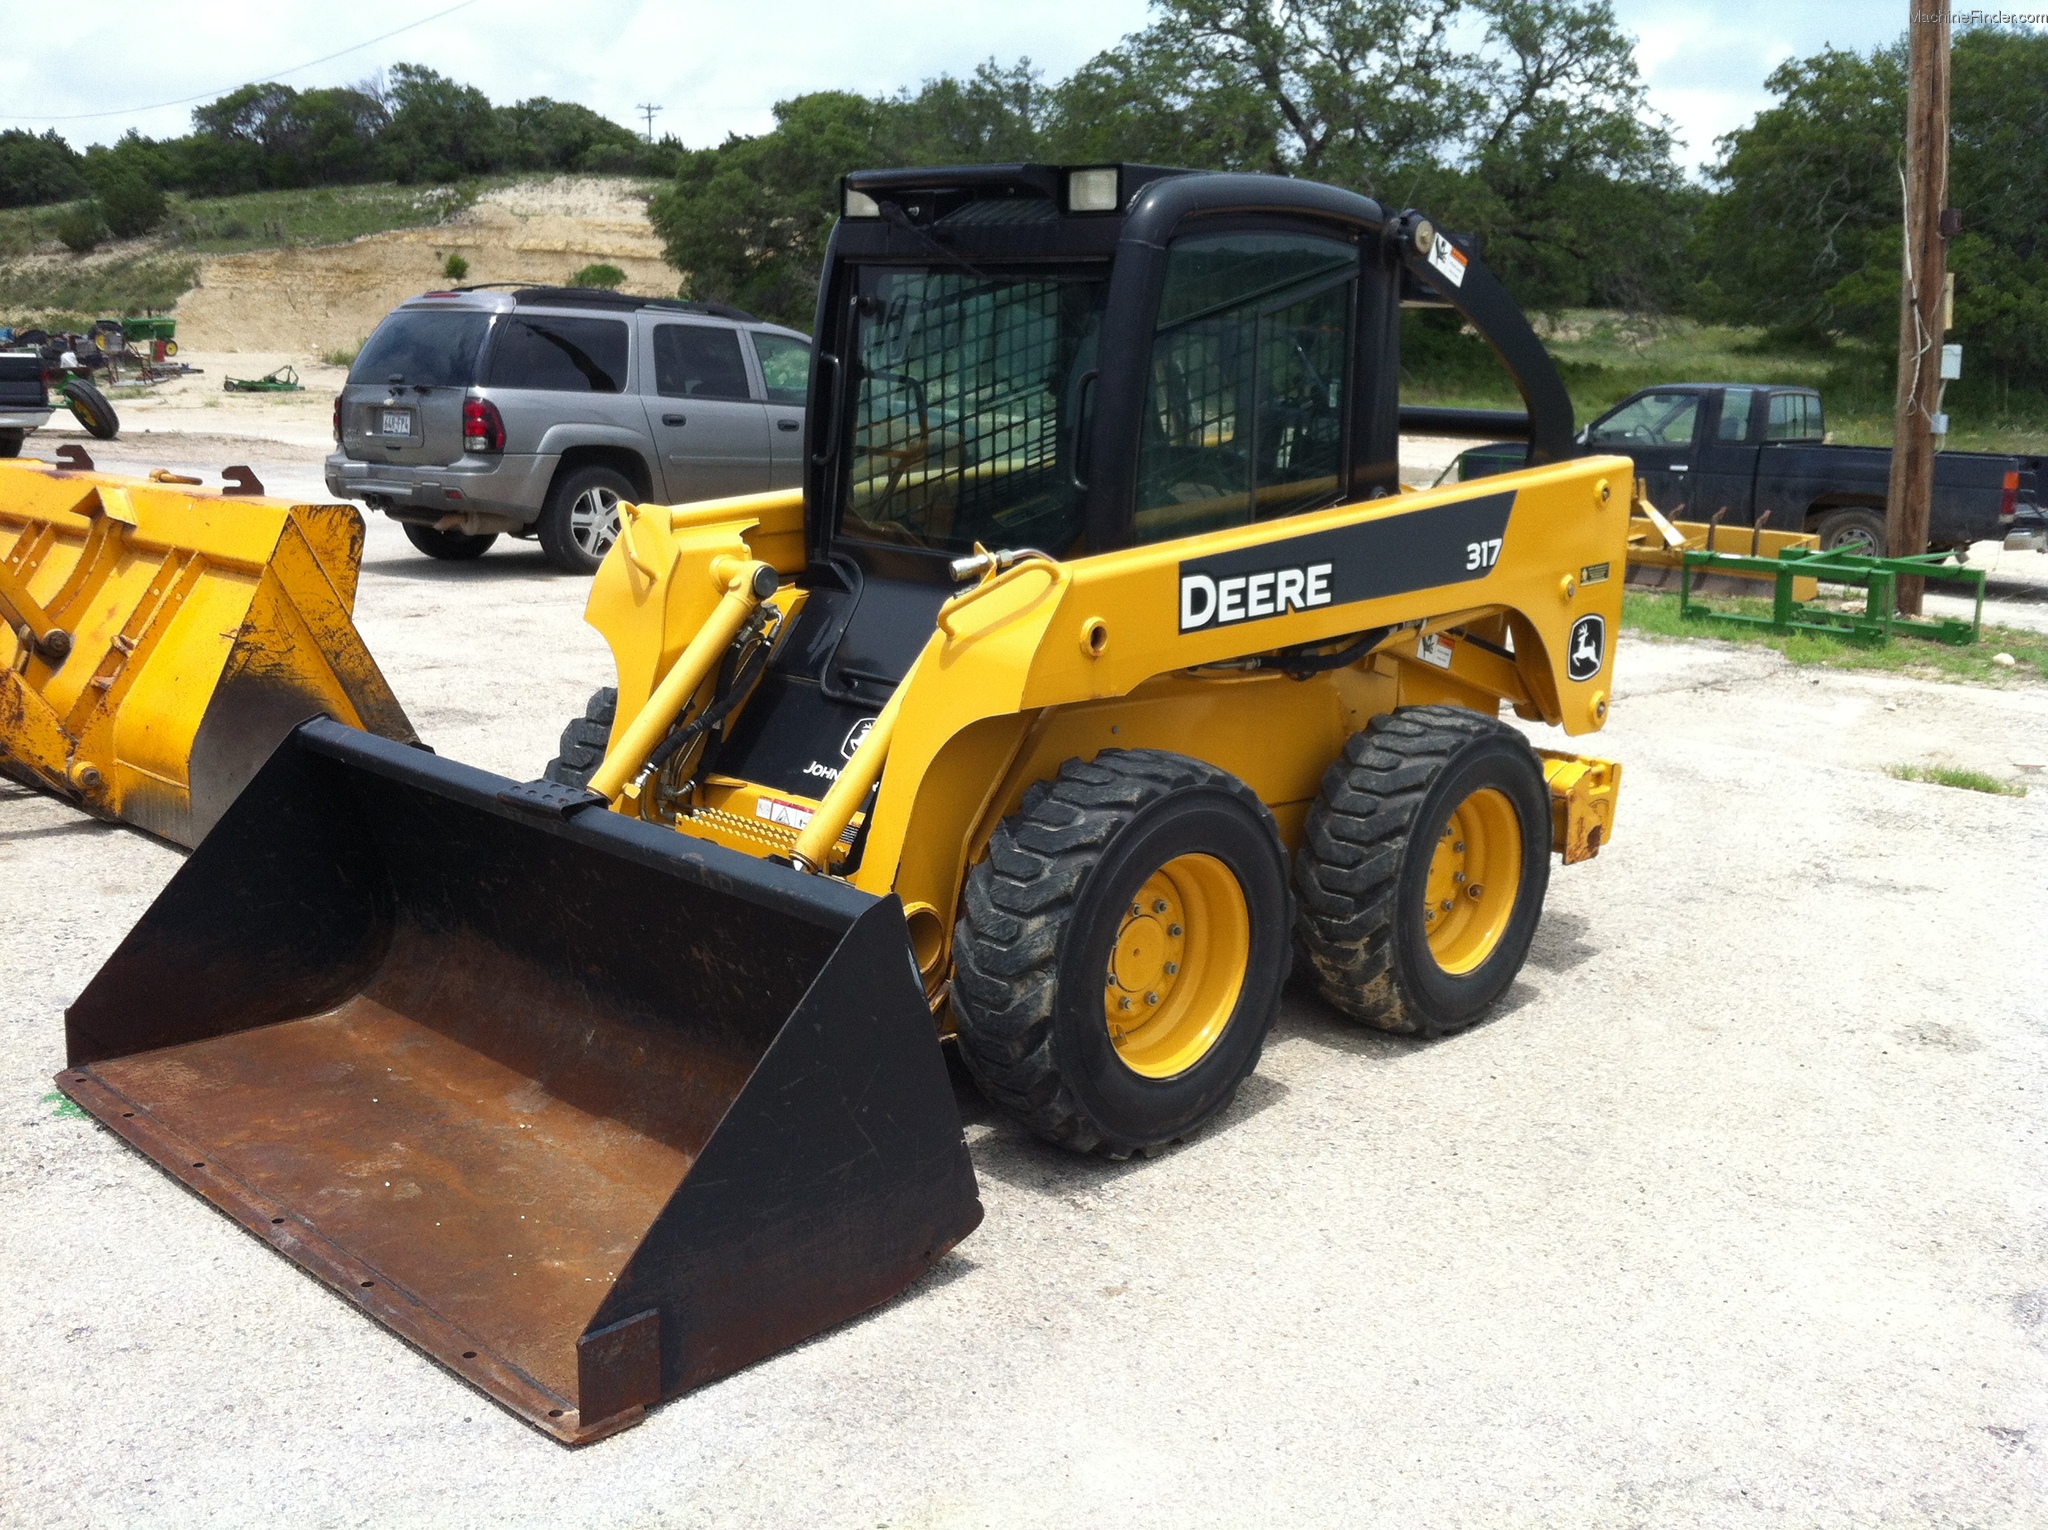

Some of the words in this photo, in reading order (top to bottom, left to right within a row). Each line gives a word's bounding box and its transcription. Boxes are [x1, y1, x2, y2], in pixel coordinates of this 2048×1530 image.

[1466, 538, 1503, 571] 317
[1181, 563, 1333, 630] DEERE
[803, 760, 842, 781] JOHN
